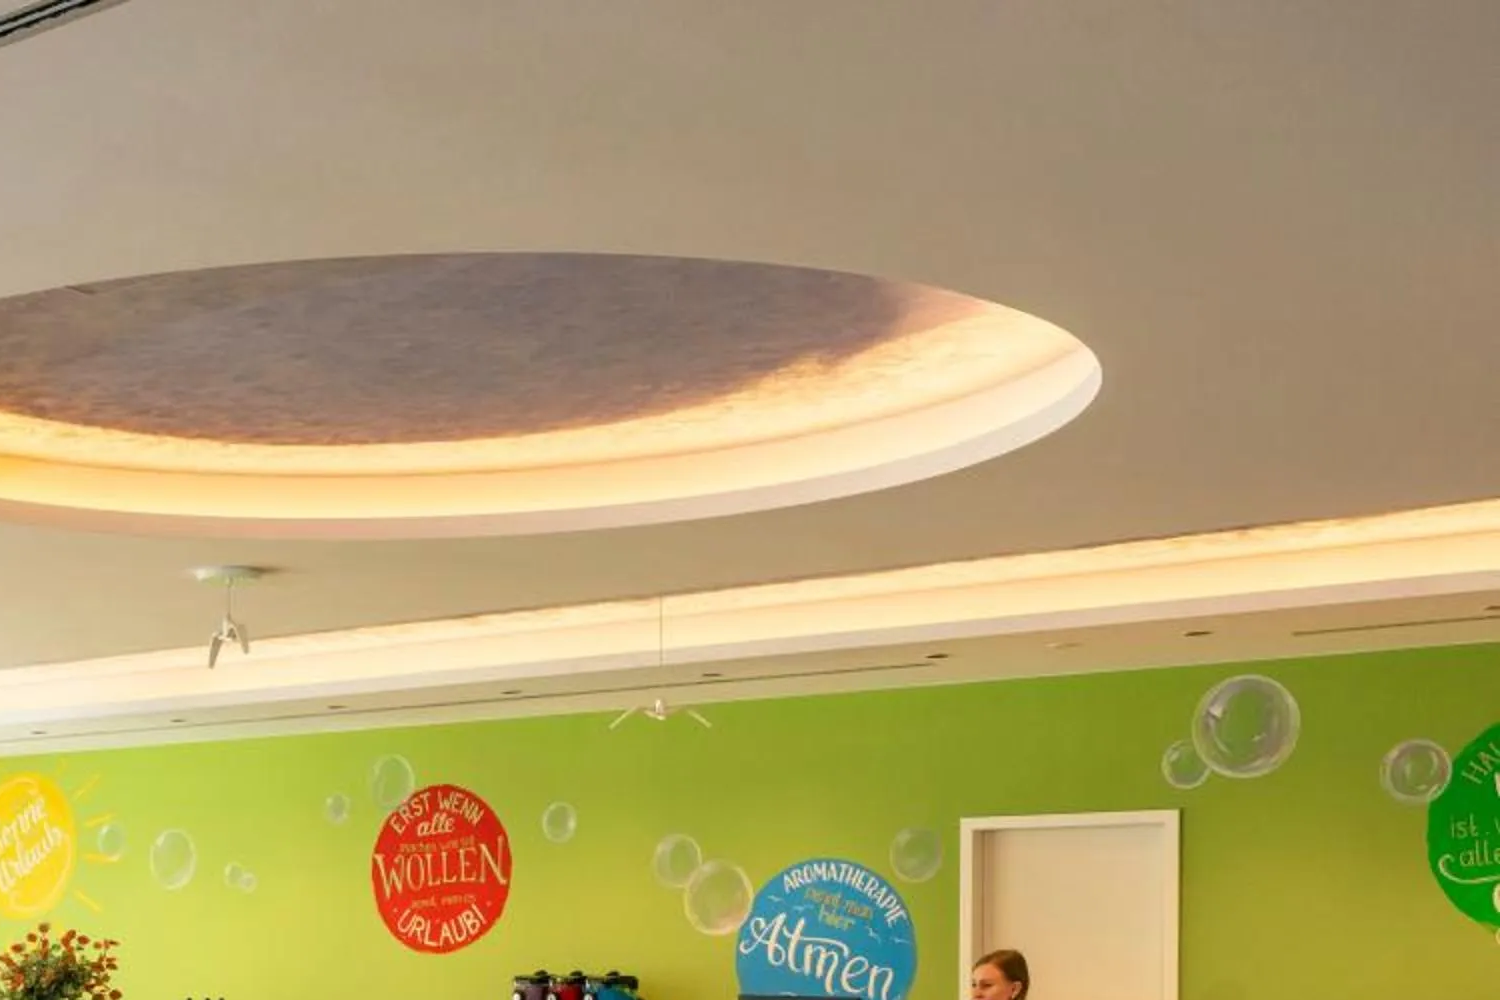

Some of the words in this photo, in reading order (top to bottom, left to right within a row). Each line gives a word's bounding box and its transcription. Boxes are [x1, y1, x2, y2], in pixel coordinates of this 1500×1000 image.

[389, 791, 430, 835] ERST
[437, 790, 484, 826] WENN
[417, 812, 455, 837] alle
[373, 834, 507, 900] WOLLEN
[783, 862, 907, 928] AROMATHERAPIE
